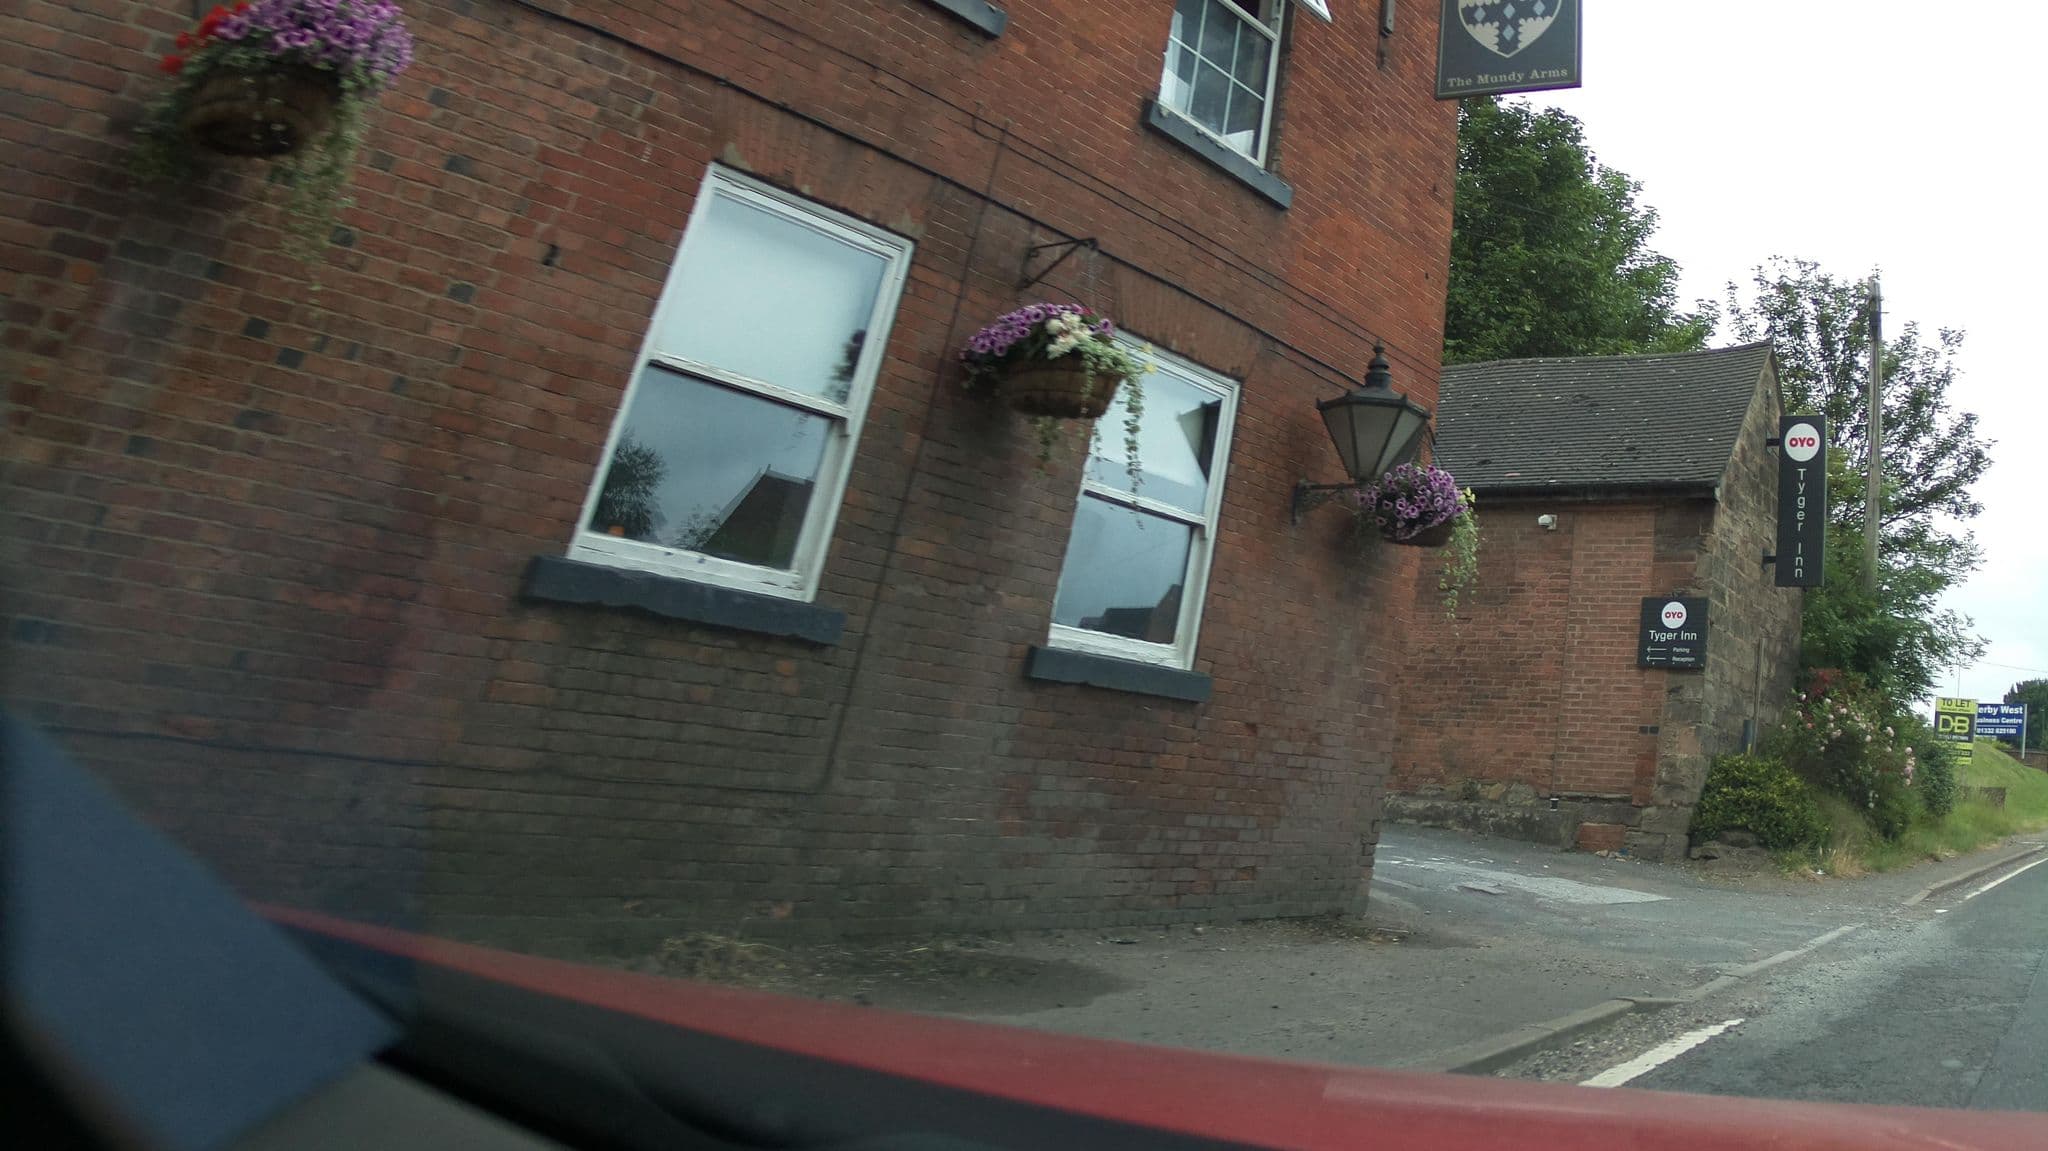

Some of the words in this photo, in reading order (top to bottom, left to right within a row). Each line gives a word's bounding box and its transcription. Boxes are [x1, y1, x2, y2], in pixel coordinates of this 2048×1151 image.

[1447, 77, 1472, 88] The
[1477, 71, 1524, 84] Mundy
[1530, 68, 1568, 80] Arms
[1789, 437, 1815, 448] OYO
[1796, 468, 1807, 531] Tyger
[1794, 542, 1804, 578] Inn
[1665, 611, 1683, 619] OYO
[1649, 630, 1678, 642] Tyger
[1680, 630, 1697, 641] Inn
[1955, 699, 1971, 708] LET
[1978, 705, 1998, 716] erby
[2000, 705, 2023, 714] West
